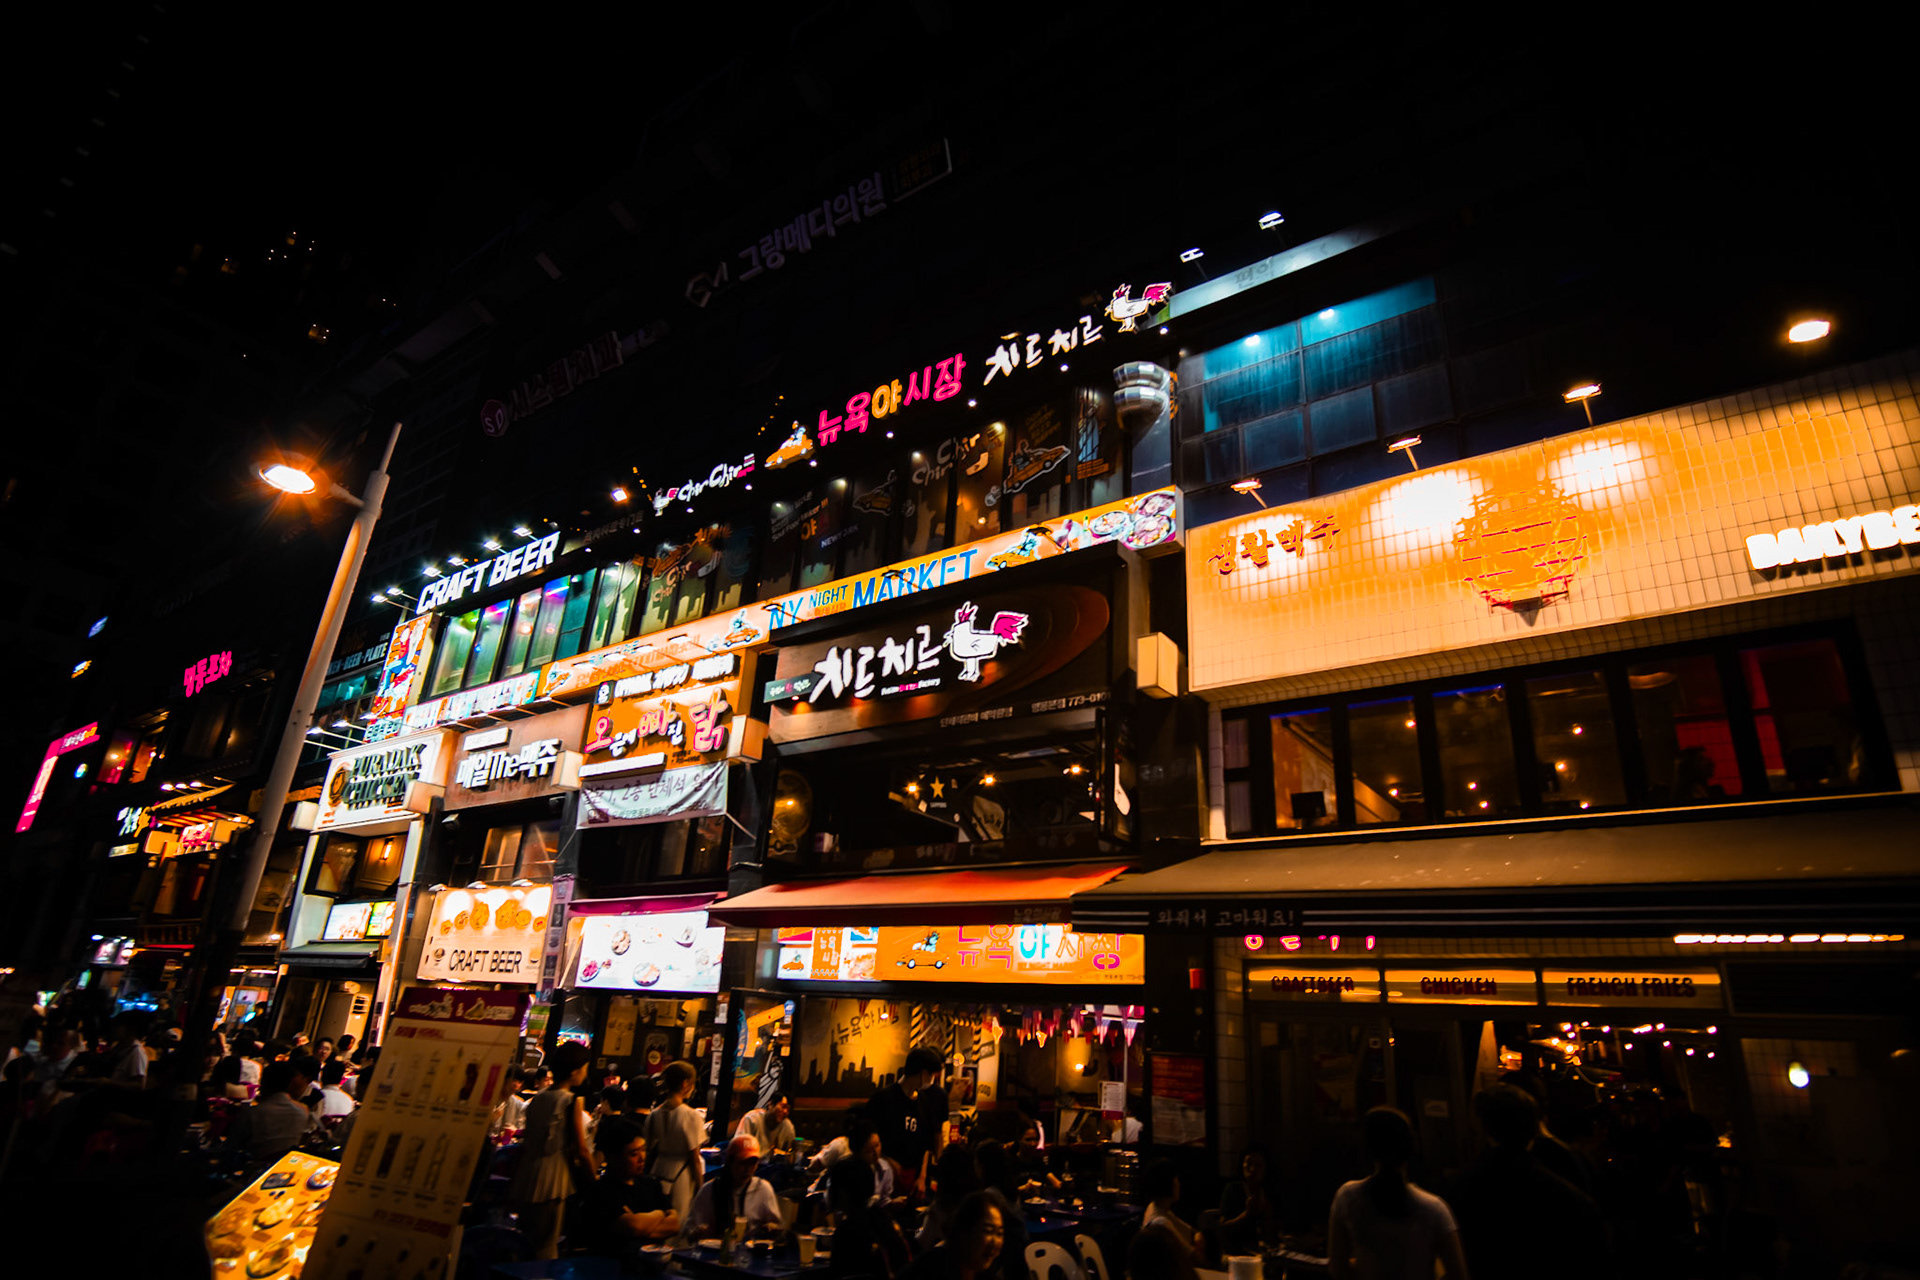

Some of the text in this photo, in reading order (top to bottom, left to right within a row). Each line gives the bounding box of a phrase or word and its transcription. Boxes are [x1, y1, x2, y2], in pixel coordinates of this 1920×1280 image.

[984, 315, 1103, 386] 치르치르
[817, 353, 966, 446] 뉴욕야시장
[415, 530, 561, 615] CRAFT BEER
[1207, 515, 1341, 576] 생활맥주
[769, 548, 979, 631] NY NIGHT MARKET
[809, 624, 943, 705] 치르치르
[688, 687, 729, 753] 닭
[1215, 907, 1295, 928] 고마워요!
[449, 949, 523, 973] CRAFT BEER
[1420, 976, 1497, 996] CHICKEN
[1567, 977, 1696, 997] FRENCH FRIES
[836, 1004, 900, 1045] 뉴욕야시
